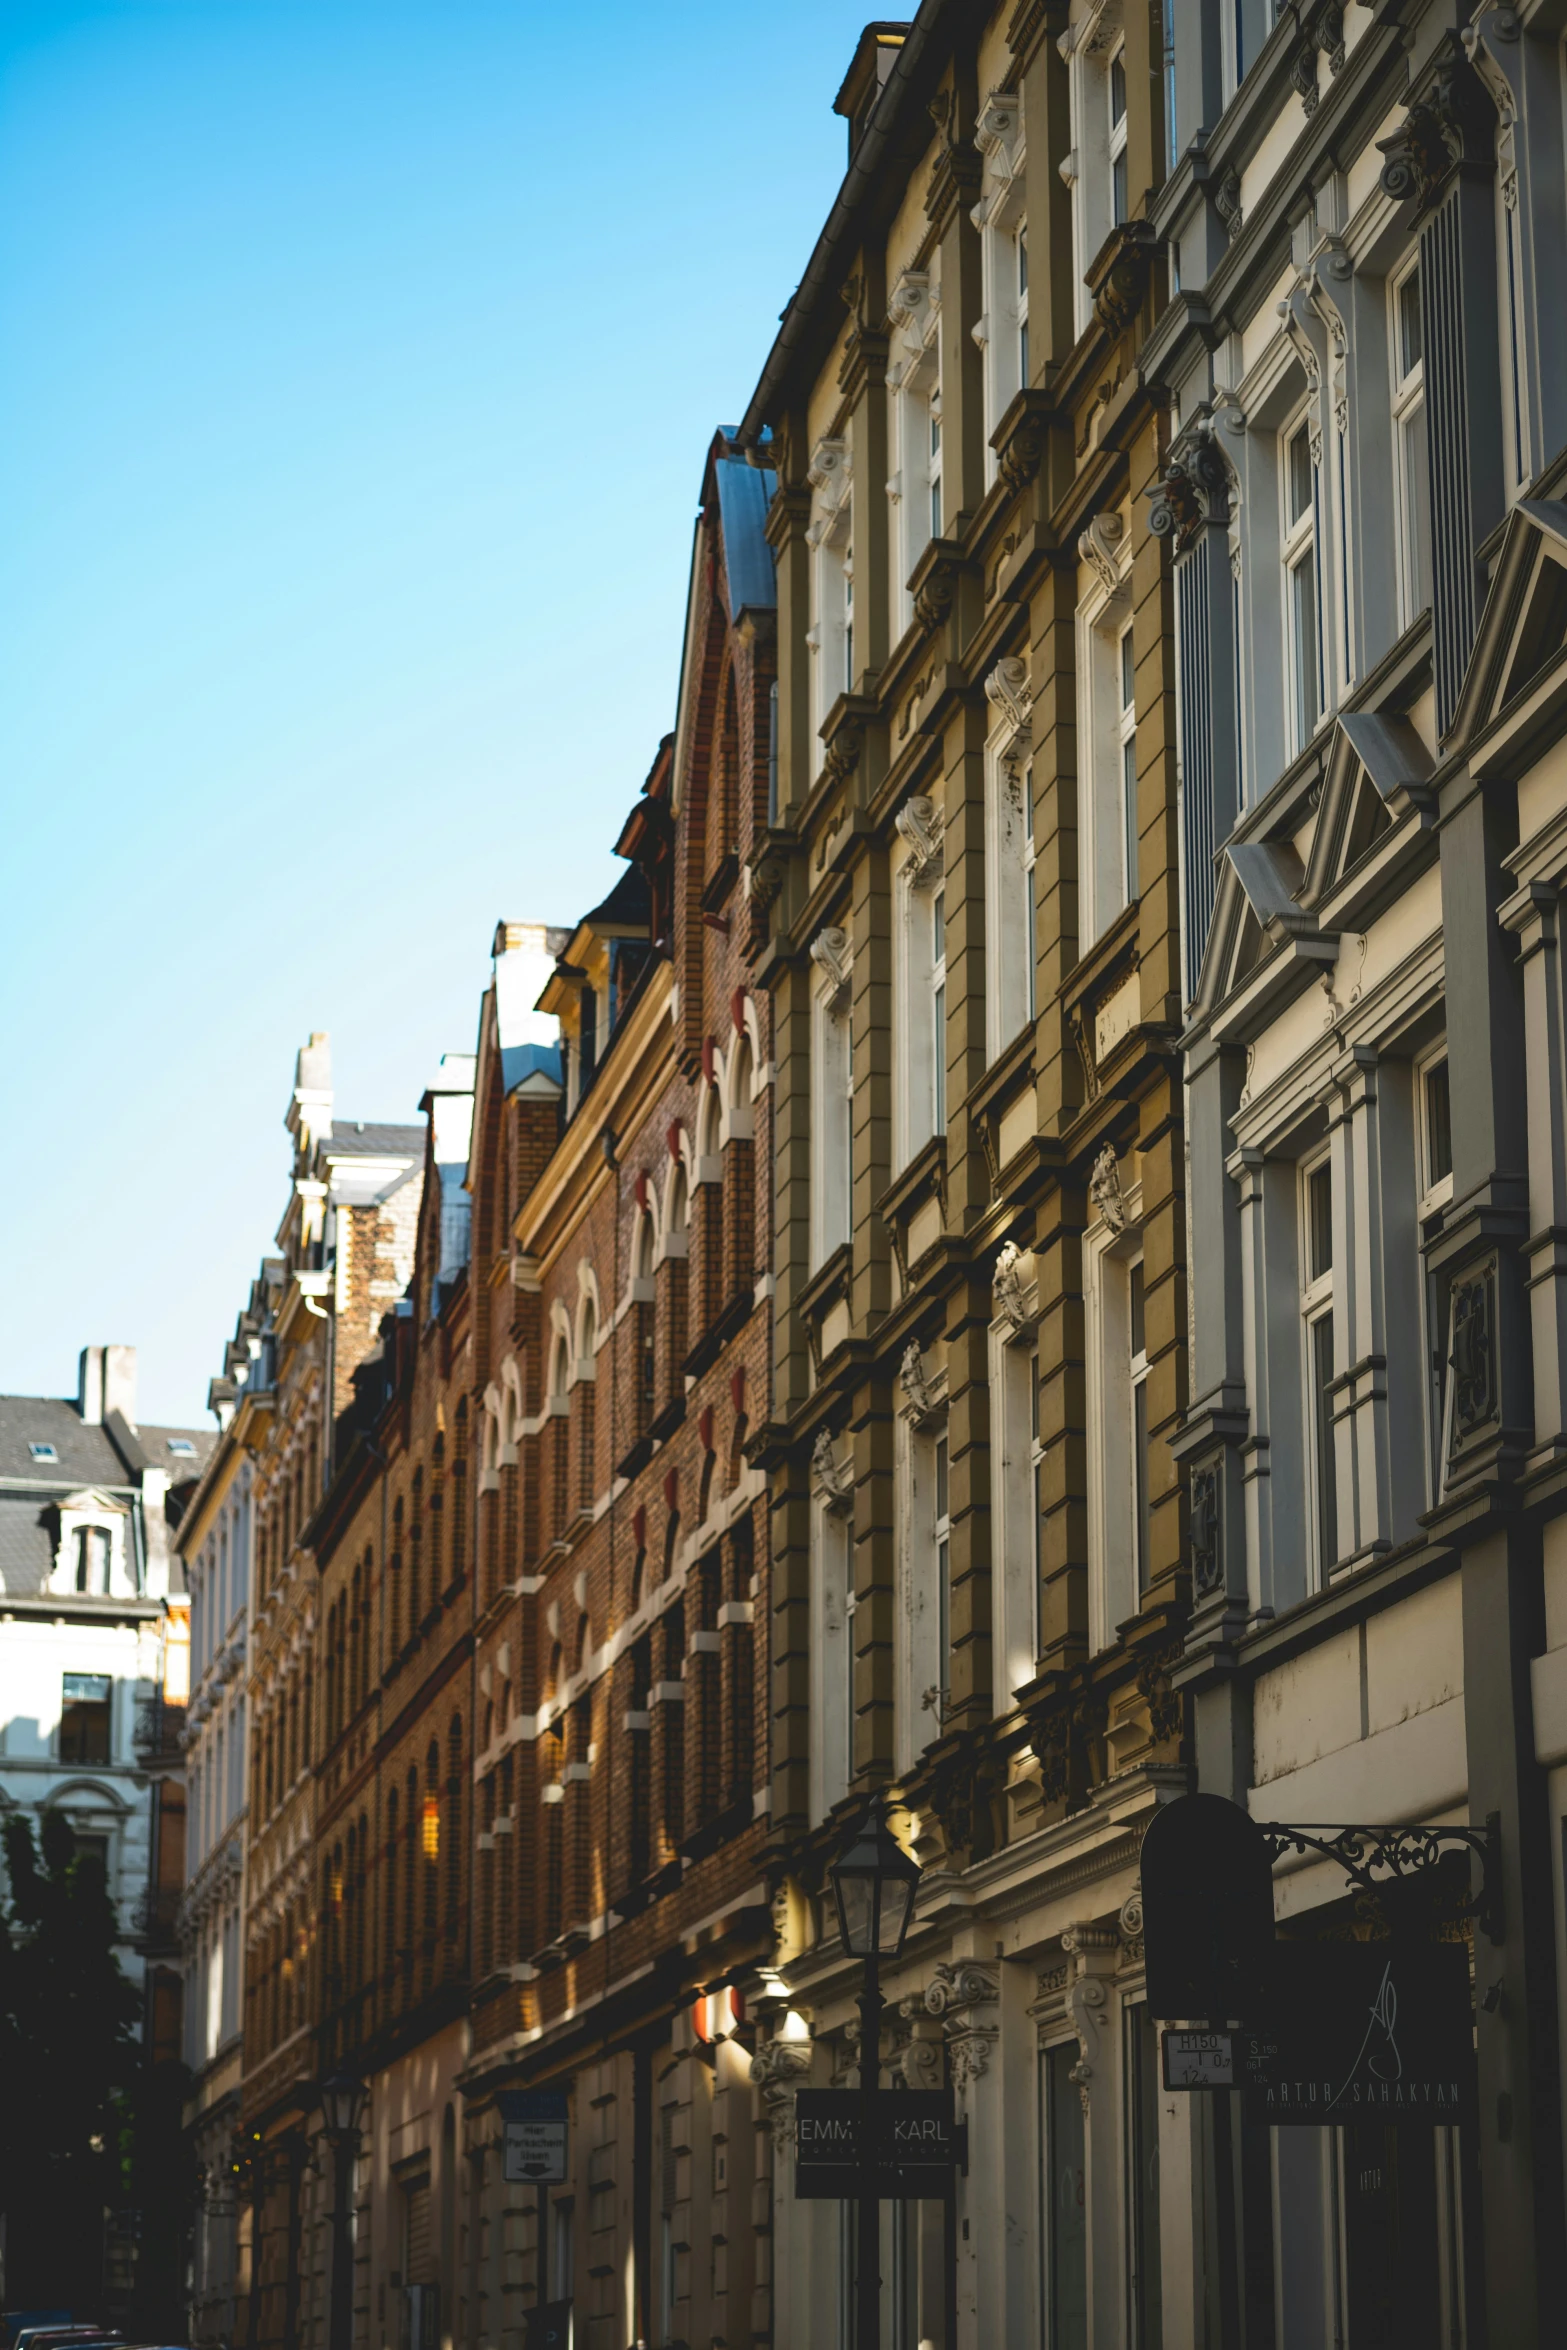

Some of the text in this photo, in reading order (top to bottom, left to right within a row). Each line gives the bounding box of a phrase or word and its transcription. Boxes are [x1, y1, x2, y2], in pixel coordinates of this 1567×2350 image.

[1181, 2035, 1217, 2049] H150
[1263, 2045, 1278, 2054] 150
[1267, 2082, 1459, 2102] ARTUR SAHAKYAN
[801, 2119, 950, 2141] EMM KARL
